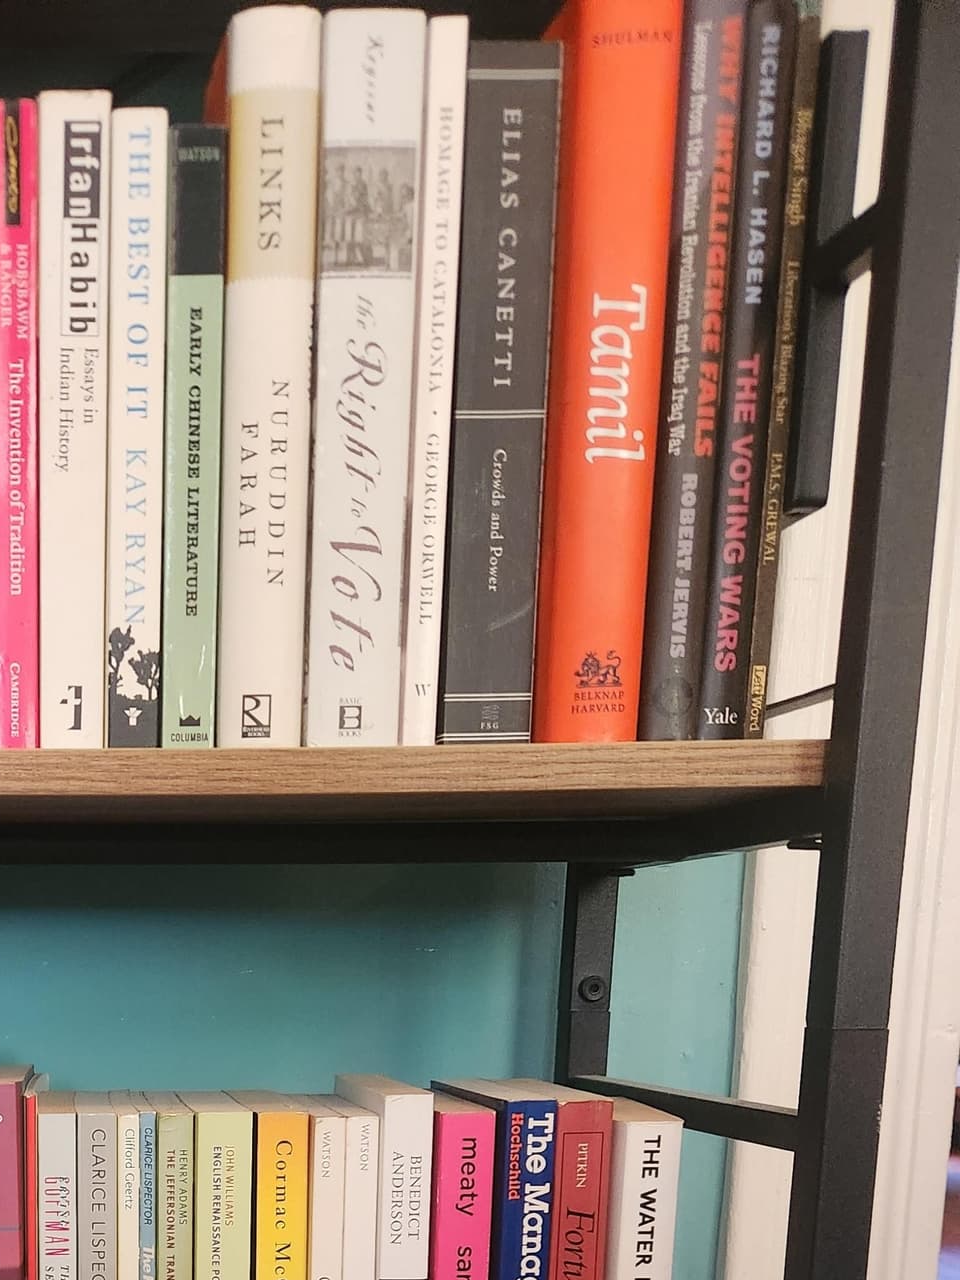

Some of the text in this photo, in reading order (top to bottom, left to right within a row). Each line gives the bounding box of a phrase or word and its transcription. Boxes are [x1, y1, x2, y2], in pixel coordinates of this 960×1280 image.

[257, 117, 283, 250] LINKS
[744, 25, 781, 305] RICHARD L. HASEN
[70, 122, 99, 332] Irfan Habib
[493, 108, 522, 387] ELIAS CANETTI
[16, 244, 29, 339] HOBSBAWM
[56, 347, 74, 472] Indian History
[124, 126, 152, 624] THE BEST OF IT KAY RYAN
[585, 283, 647, 463] Tamil
[7, 358, 25, 595] The Invention of Tradition
[186, 307, 202, 616] EARLY CHINESE LITERATURE
[239, 422, 259, 548] FARAH
[267, 380, 289, 586] NURUDDIN
[487, 449, 507, 592] Crowds and Power
[715, 353, 761, 672] THE VOTING WARS
[670, 473, 698, 658] ROBERT JERVIS
[10, 662, 21, 737] CAMBRIDGE
[170, 732, 209, 743] COLUMBIA
[571, 703, 625, 714] HARVARD
[574, 690, 625, 701] BELKNAP
[704, 708, 738, 724] Yale
[166, 1150, 175, 1168] THE
[213, 1146, 221, 1190] ENGLISH
[225, 1146, 235, 1226] JOHN WILLIAMS
[275, 1140, 293, 1230] Cormac
[321, 1131, 331, 1178] WATSON
[455, 1138, 478, 1217] meaty
[526, 1113, 554, 1174] The
[641, 1135, 661, 1179] THE
[166, 1174, 176, 1249] JEFFERSONIAN
[179, 1150, 188, 1225] HENRY ADAMS
[212, 1194, 221, 1266] RENAISSANCE
[390, 1151, 405, 1245] ANDERSON
[408, 1156, 422, 1240] BENEDICT
[634, 1189, 657, 1267] WATER
